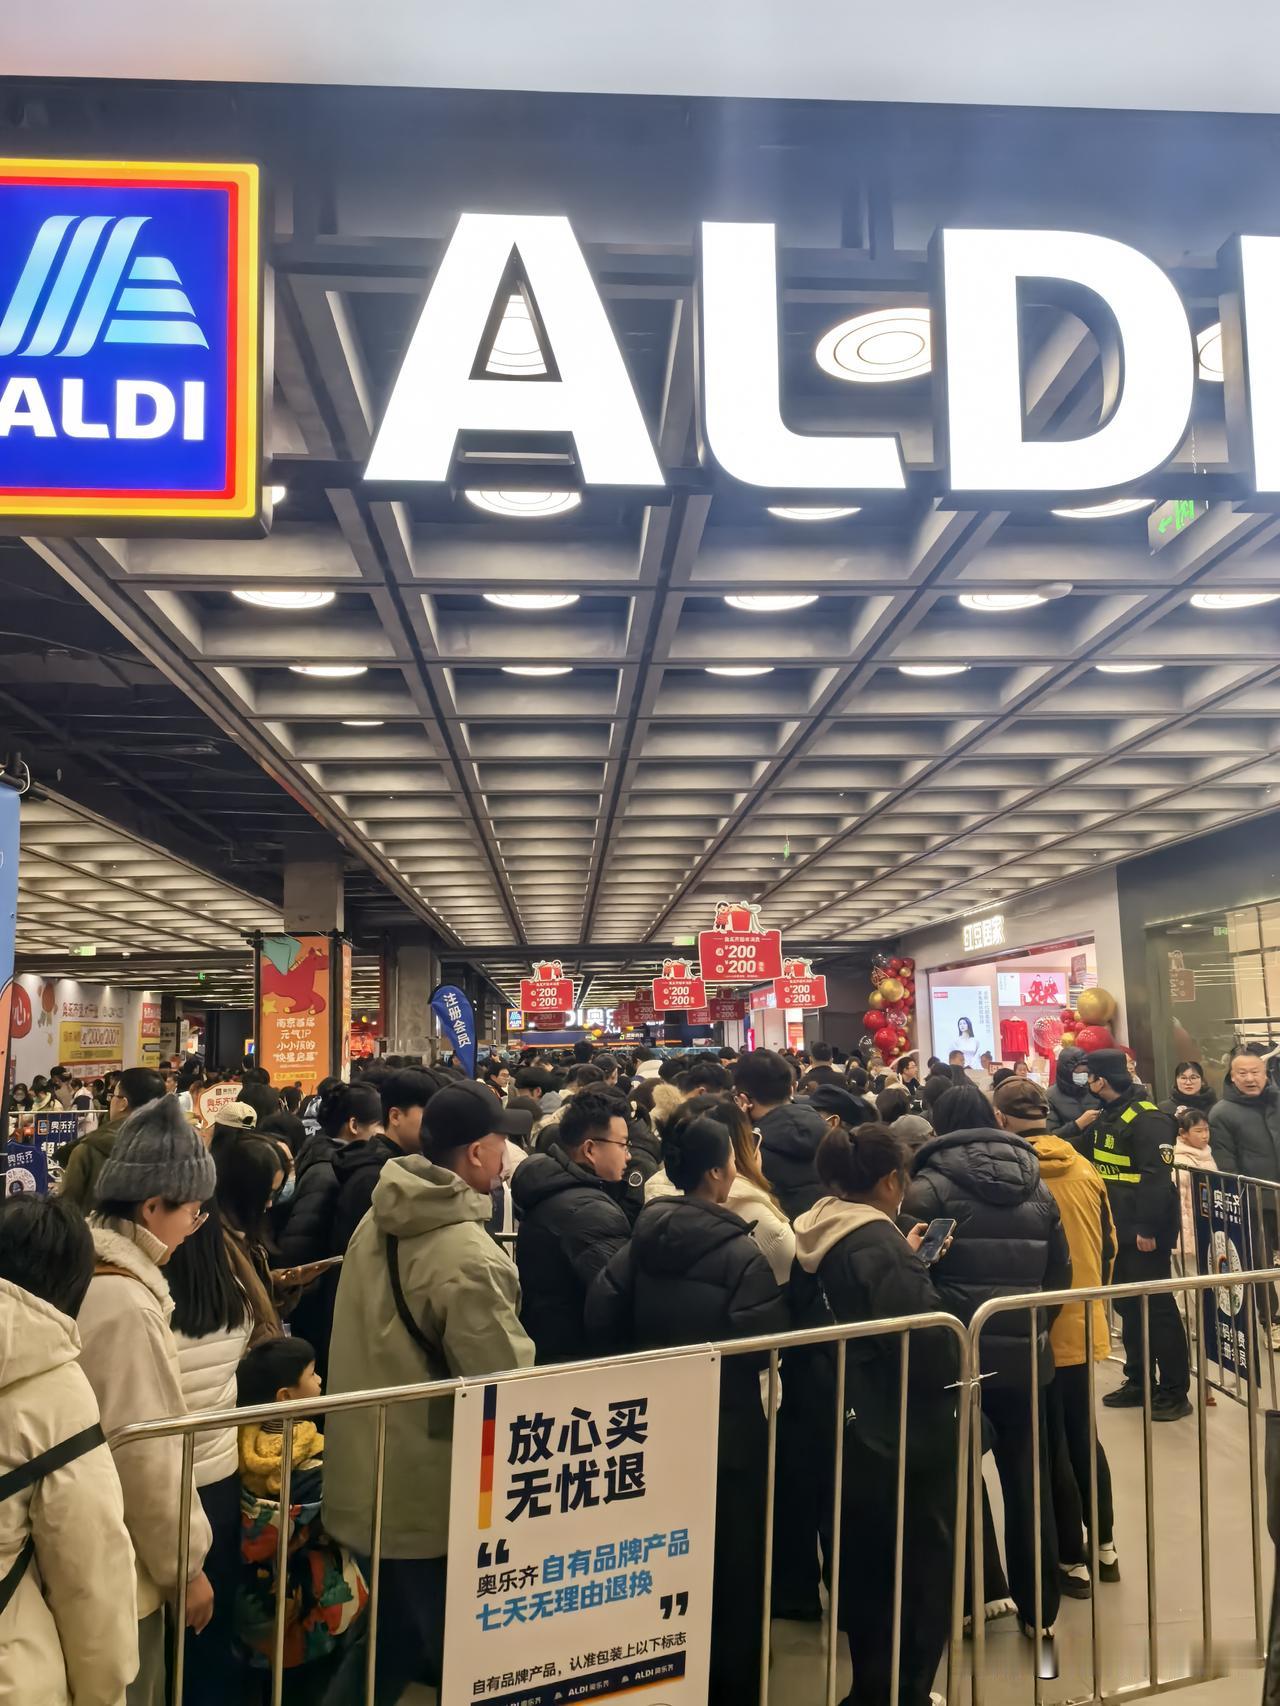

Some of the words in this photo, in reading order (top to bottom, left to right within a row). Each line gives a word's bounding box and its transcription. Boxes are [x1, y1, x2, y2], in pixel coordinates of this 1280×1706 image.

[0, 376, 205, 441] ALDI
[281, 1029, 311, 1039] 元气IP
[443, 992, 471, 1048] 注册会员
[51, 1121, 76, 1130] 奥乐齐
[507, 1398, 648, 1465] 放心买
[505, 1451, 646, 1523] 无忧退
[475, 1569, 653, 1631] 七天无理由退换
[568, 1685, 588, 1697] ALDI
[634, 1669, 654, 1680] ALDI
